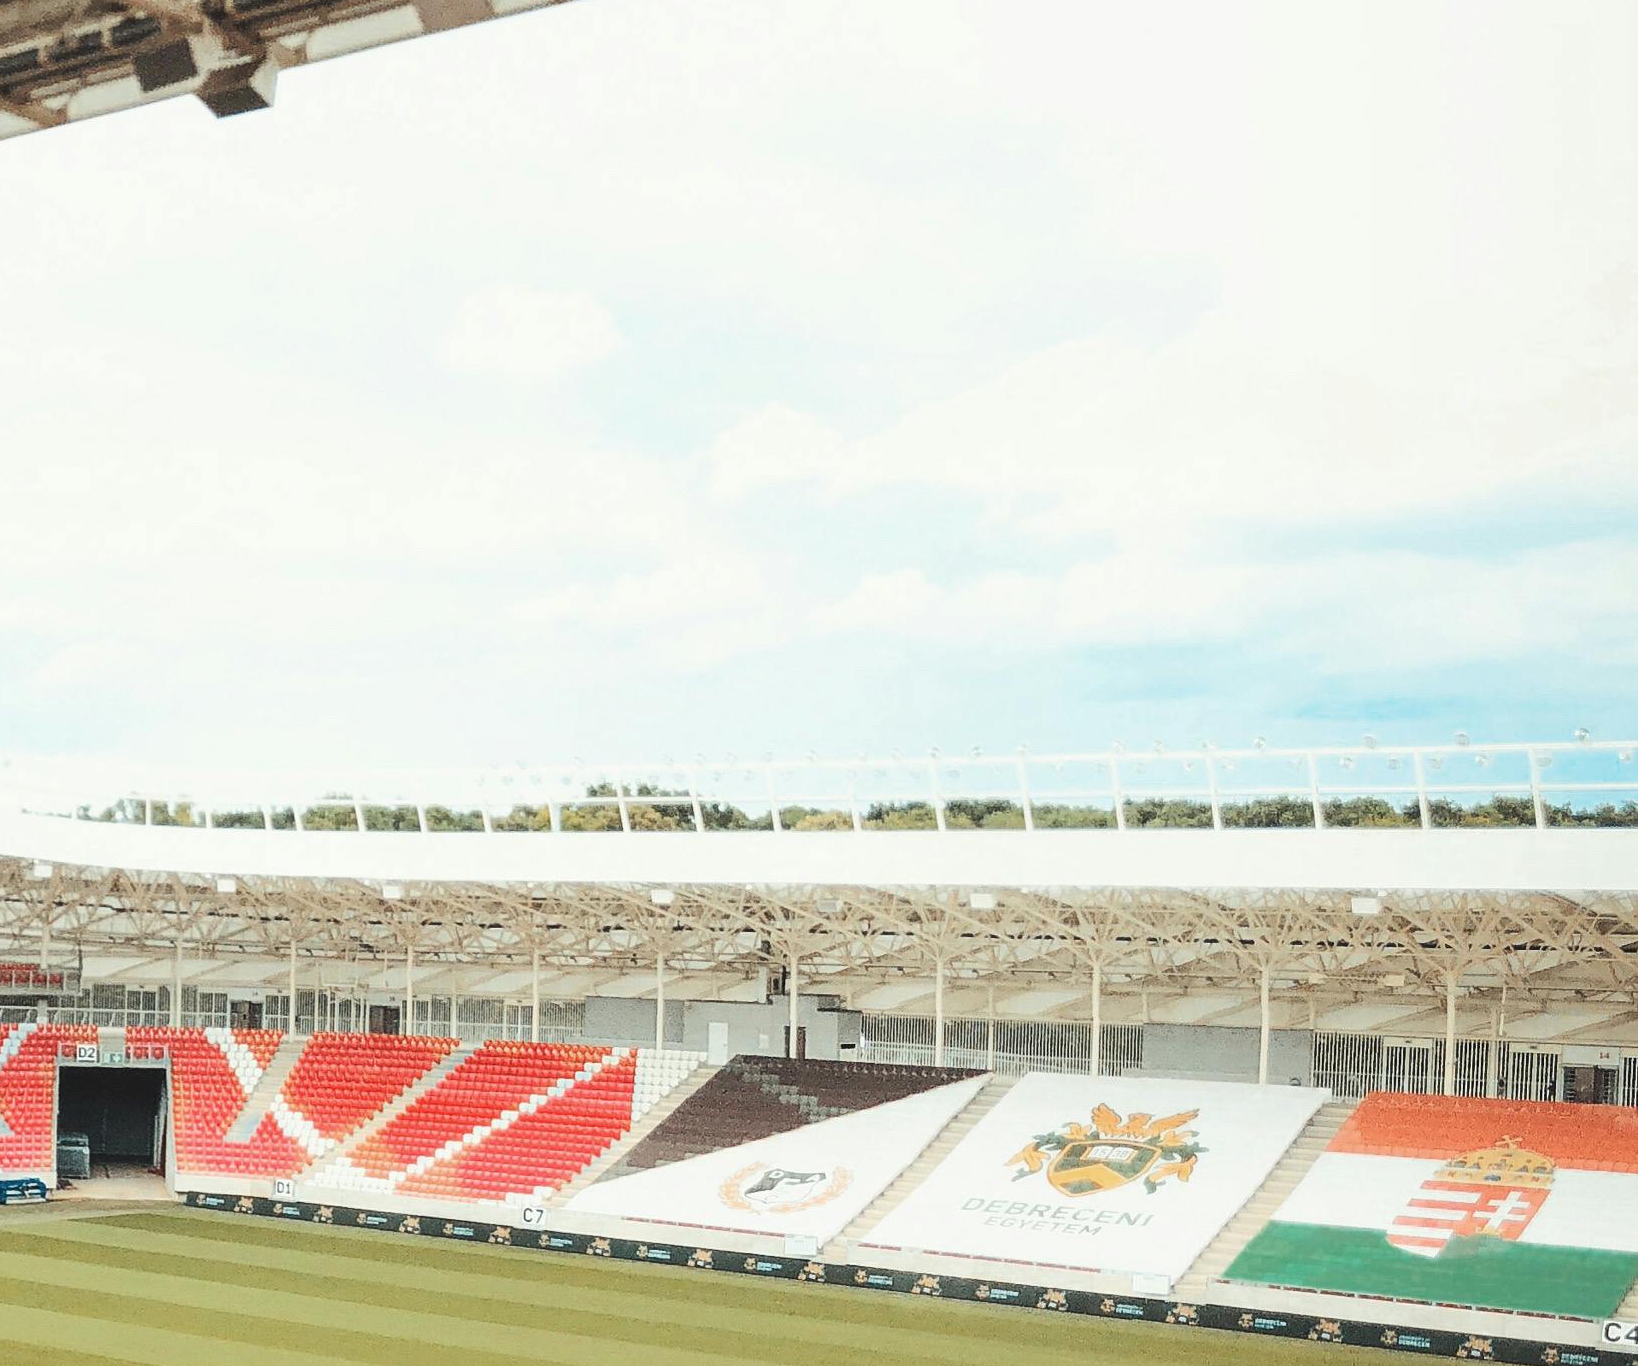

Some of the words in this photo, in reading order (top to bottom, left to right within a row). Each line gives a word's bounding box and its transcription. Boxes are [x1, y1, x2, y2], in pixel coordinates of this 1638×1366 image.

[78, 1046, 96, 1058] D2
[276, 1181, 291, 1194] D1
[523, 1207, 544, 1223] C7
[961, 1197, 1155, 1227] DEBRECENI
[983, 1215, 1103, 1236] EGYETEM
[1604, 1322, 1638, 1345] C4
